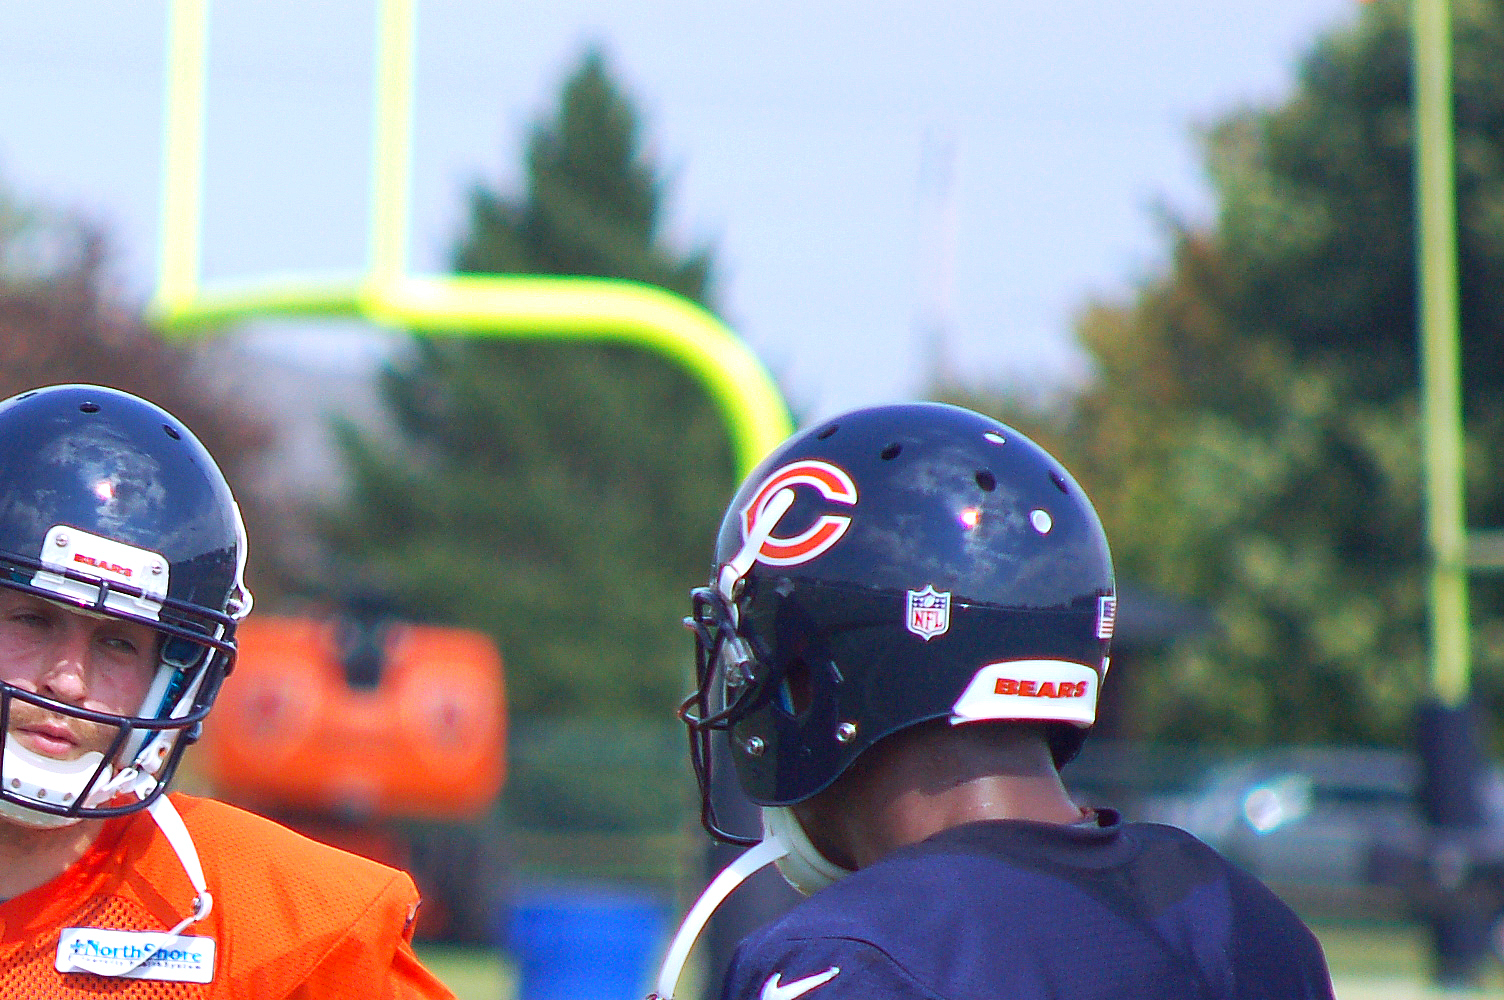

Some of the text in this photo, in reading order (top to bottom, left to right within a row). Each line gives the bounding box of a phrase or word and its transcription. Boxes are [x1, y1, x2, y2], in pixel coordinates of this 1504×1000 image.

[73, 553, 133, 577] BEARS
[914, 610, 943, 630] NFL
[994, 677, 1089, 698] BEARS
